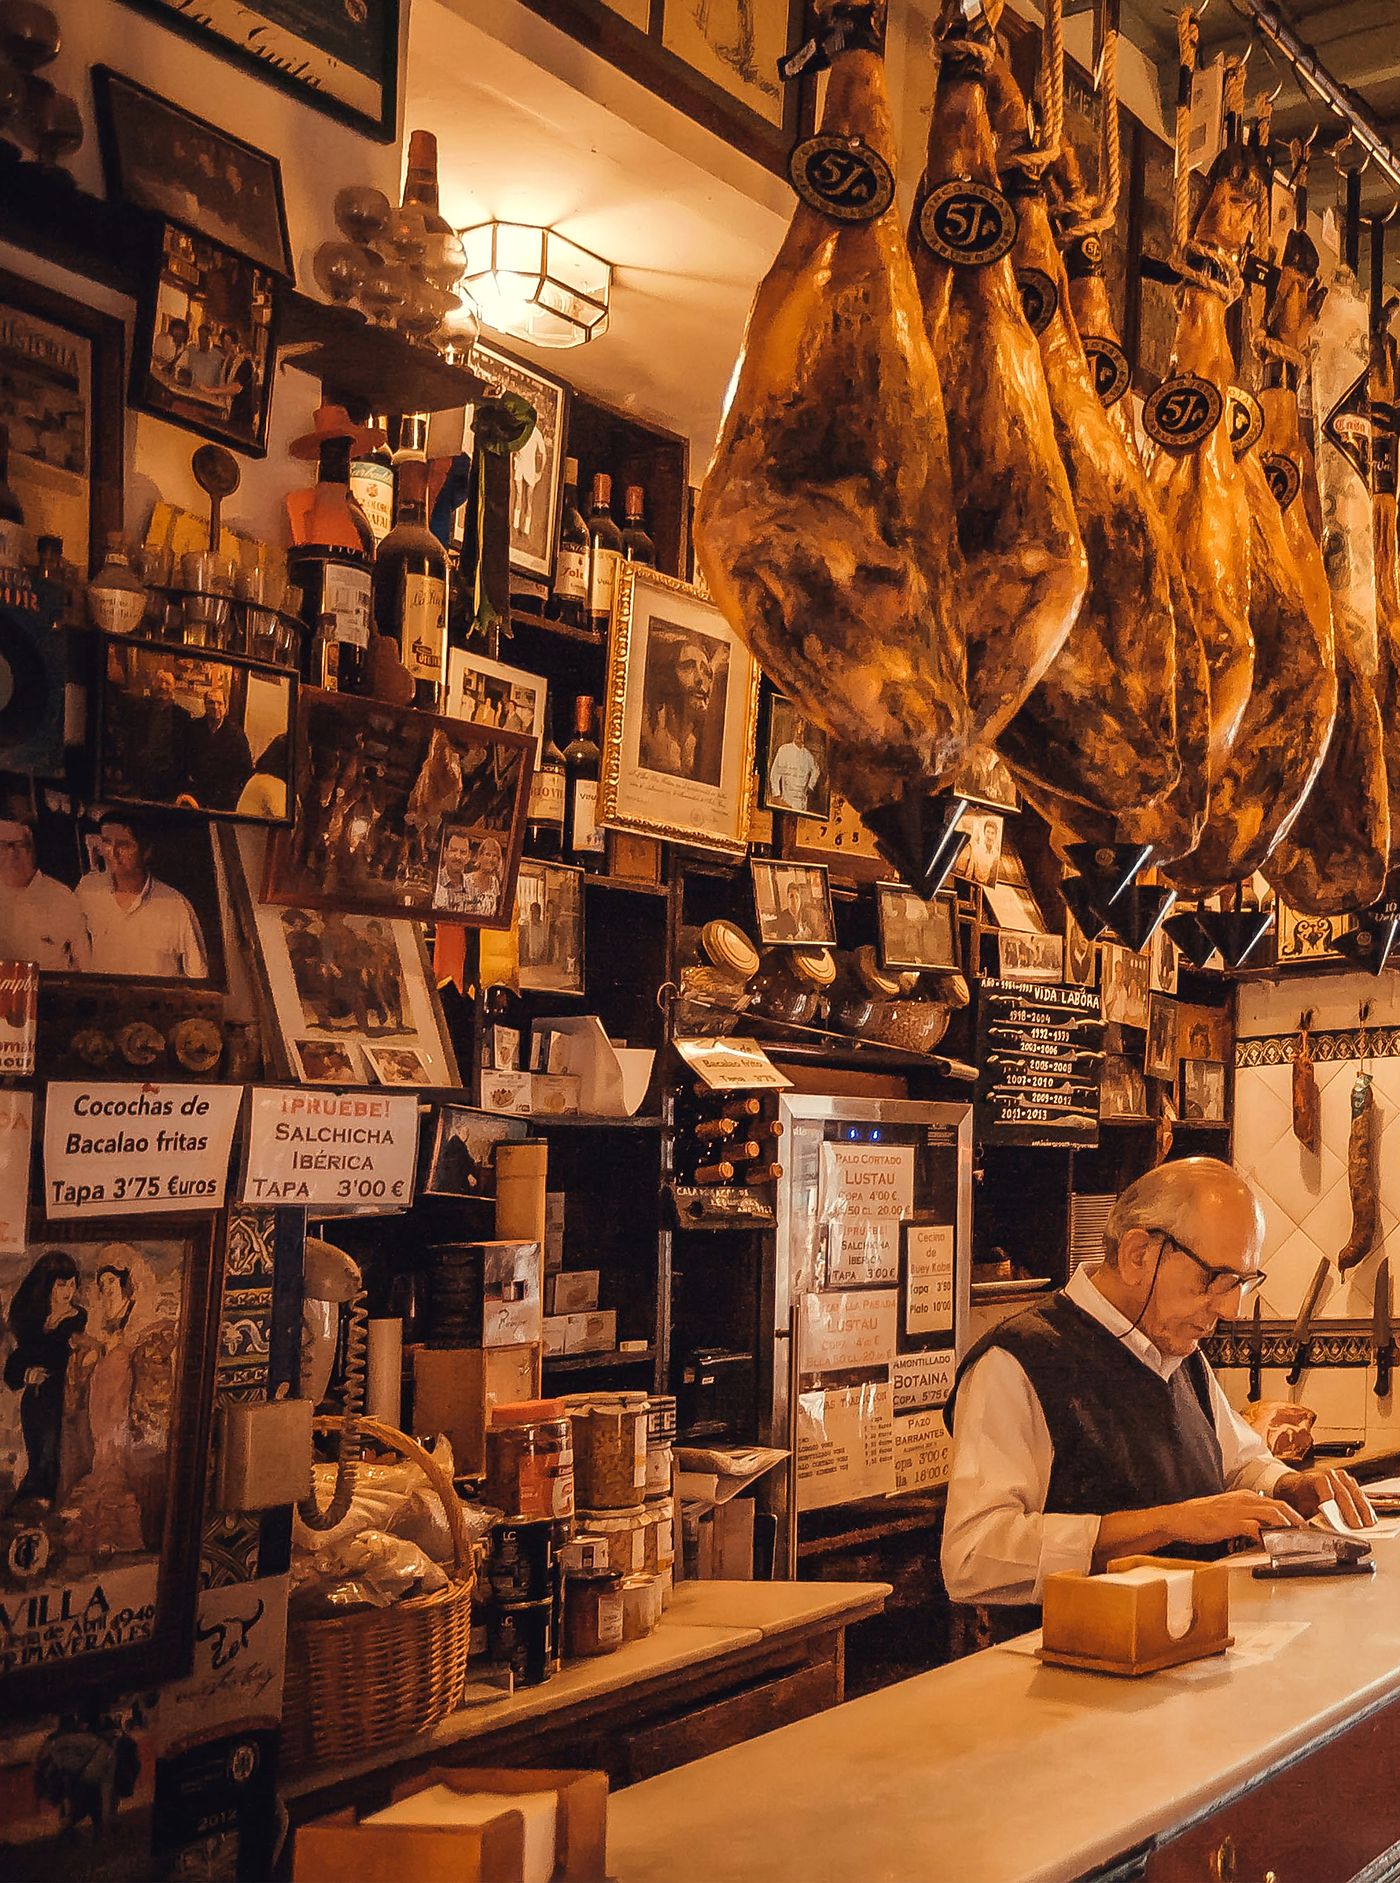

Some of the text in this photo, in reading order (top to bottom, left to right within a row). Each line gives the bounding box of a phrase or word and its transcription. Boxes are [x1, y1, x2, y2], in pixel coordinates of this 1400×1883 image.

[1034, 987, 1057, 1001] VIDA
[74, 1094, 210, 1117] Cocochas de
[281, 1096, 391, 1118] ¡PRUEBE!
[65, 1130, 209, 1155] Bacalao fritas
[275, 1123, 395, 1145] SALCHICHA
[292, 1150, 375, 1171] IBÉRICA
[845, 1170, 895, 1186] LUSTAU
[52, 1181, 105, 1207] Tapa
[113, 1176, 161, 1200] 3'75
[253, 1178, 405, 1198] TAPA 3'00 €
[893, 1355, 951, 1370] AMONTILLADO
[893, 1371, 949, 1390] BOTAINA
[908, 1417, 932, 1430] PAZO
[894, 1428, 945, 1447] BARRANTES
[895, 1457, 913, 1472] opa
